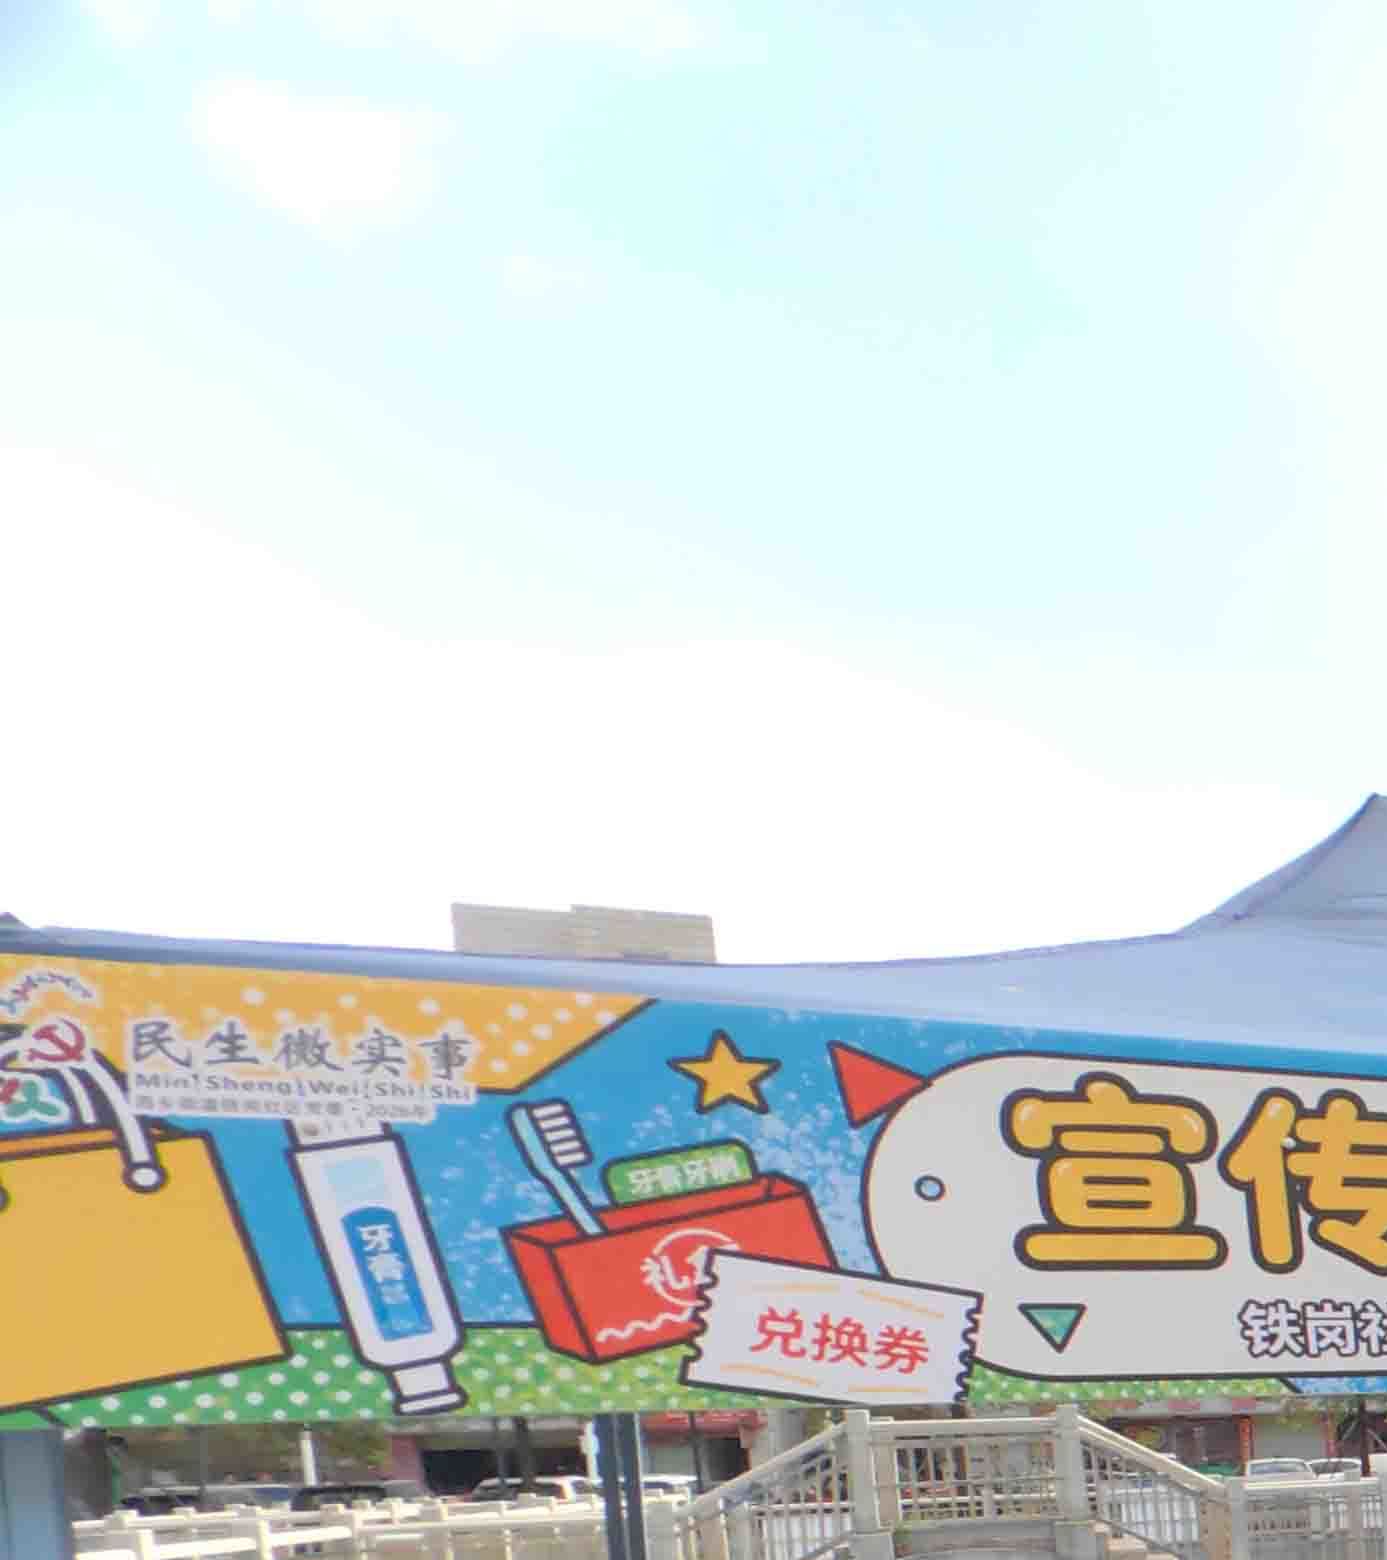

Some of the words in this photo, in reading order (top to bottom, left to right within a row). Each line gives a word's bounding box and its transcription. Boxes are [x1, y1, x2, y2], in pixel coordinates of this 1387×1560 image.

[132, 1020, 472, 1080] 民生微实事
[749, 1305, 930, 1376] 兑换券
